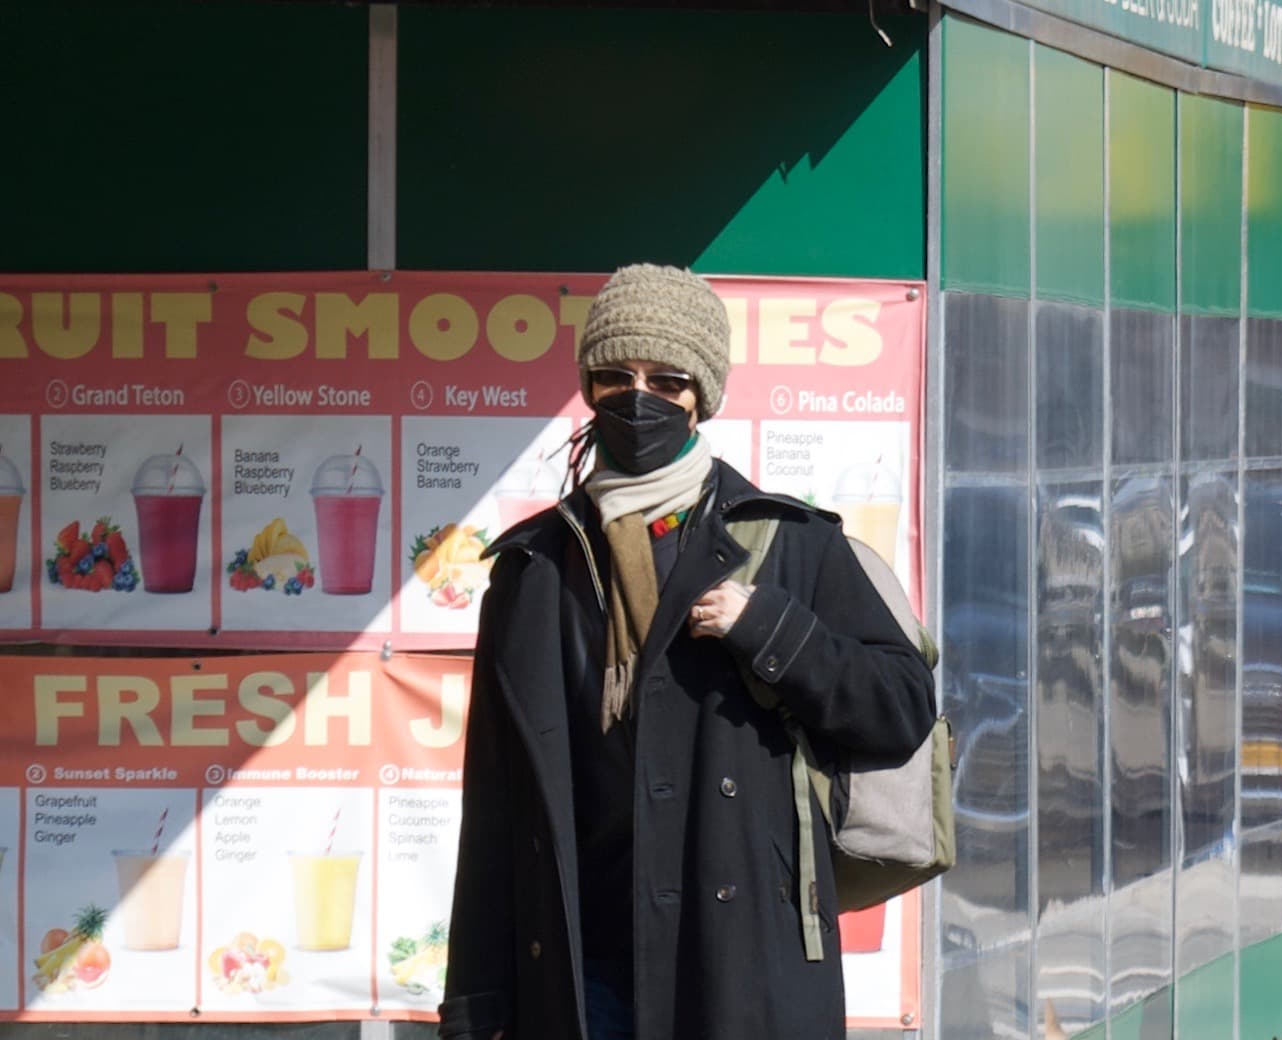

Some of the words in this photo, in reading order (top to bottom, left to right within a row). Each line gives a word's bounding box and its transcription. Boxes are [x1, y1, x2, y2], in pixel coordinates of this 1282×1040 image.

[72, 384, 128, 405] Grand
[132, 384, 184, 405] Teton
[253, 385, 313, 406] Yellow
[317, 385, 371, 406] Stone
[445, 385, 478, 411] Key
[482, 386, 528, 407] West
[798, 391, 838, 412] Pina
[842, 391, 905, 413] Colada
[766, 430, 824, 446] Pineapple
[50, 441, 107, 459] Strawberry
[234, 449, 280, 463] Banana
[416, 443, 460, 460] Orange
[766, 446, 811, 460] Banana
[50, 459, 105, 477] Raspberry
[234, 465, 295, 482] Raspberry
[416, 459, 480, 476] Strawberry
[766, 462, 814, 476] Coconut
[50, 476, 102, 494] Blueberry
[234, 480, 291, 498] Blueberry
[416, 475, 462, 489] Banana
[33, 671, 372, 747] FRESH
[54, 767, 110, 781] Sunset
[115, 767, 178, 782] Sparkle
[227, 768, 292, 781] Immune
[295, 767, 360, 781] Booster
[35, 794, 97, 809] Grapefruit
[214, 795, 262, 810] Orange
[388, 795, 449, 810] Pineapple
[35, 812, 97, 827] Pineapple
[214, 814, 257, 825] Lemon
[388, 813, 451, 826] Cucumber
[34, 830, 76, 846] Ginger
[215, 831, 251, 844] Apple
[215, 849, 257, 863] Ginger
